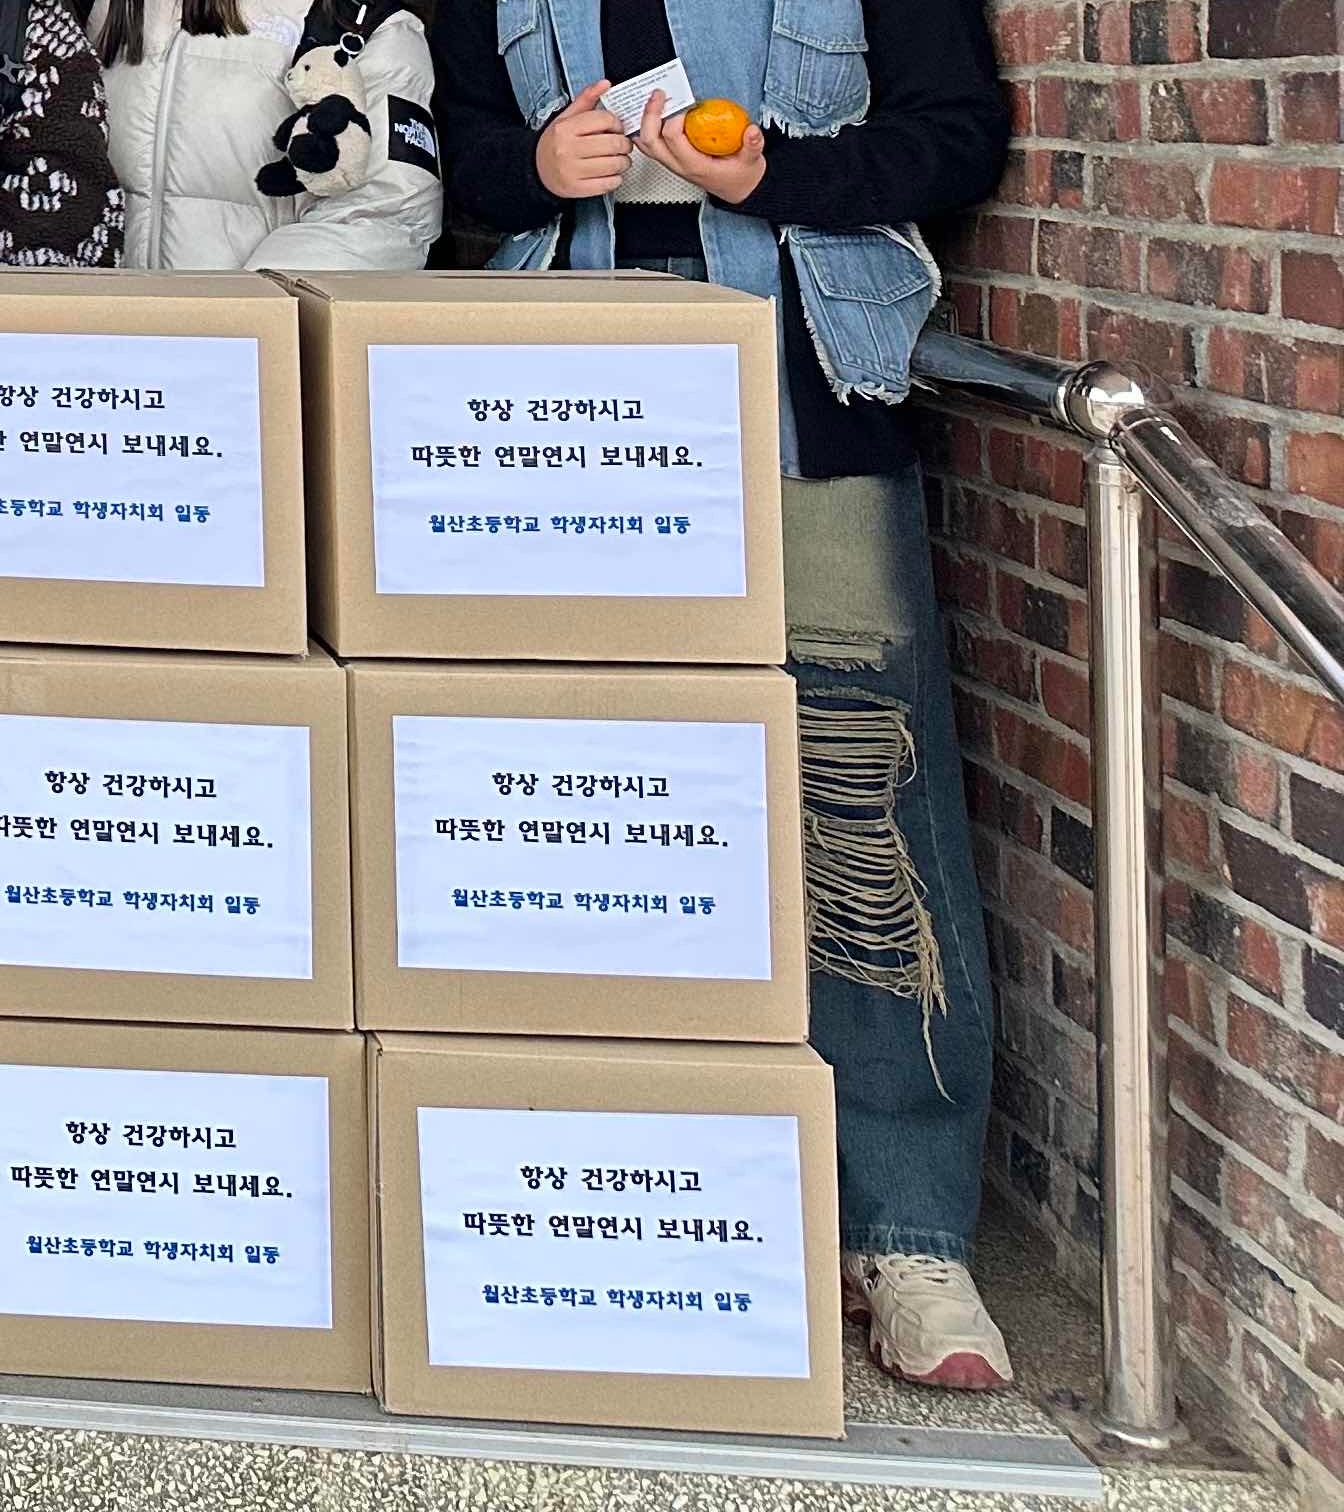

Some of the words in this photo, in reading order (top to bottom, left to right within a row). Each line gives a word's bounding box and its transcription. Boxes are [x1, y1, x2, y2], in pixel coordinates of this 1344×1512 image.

[50, 385, 165, 411] 건강하시고
[466, 397, 515, 422] 항상
[526, 398, 644, 422] 건강하시고
[18, 430, 108, 456] 연말연시
[120, 433, 223, 458] 보내세요.
[409, 444, 482, 468] 따뜻한
[493, 444, 586, 469] 연말연시
[599, 444, 703, 468] 보내세요.
[71, 499, 164, 522] 학생자치회
[174, 503, 211, 524] 일동
[427, 513, 541, 534] 월산초등학교
[548, 514, 643, 535] 학생자치회
[653, 514, 691, 535] 일동
[43, 769, 91, 795] 항상
[101, 773, 217, 800] 건강하시고
[490, 771, 540, 796] 항상
[550, 773, 670, 799] 건강하시고
[69, 817, 159, 845] 연말연시
[171, 822, 273, 849] 보내세요.
[433, 816, 506, 842] 따뜻한
[517, 819, 610, 845] 연말연시
[623, 822, 728, 848] 보내세요.
[3, 883, 114, 908] 월산초등학교
[121, 889, 214, 913] 학생자치회
[223, 894, 261, 915] 일동
[450, 887, 564, 910] 월산초등학교
[572, 891, 668, 914] 학생자치회
[678, 894, 716, 915] 일동
[64, 1120, 111, 1146] 항상
[121, 1123, 237, 1150] 건강하시고
[9, 1164, 79, 1190] 따뜻한
[89, 1168, 179, 1195] 연말연시
[191, 1172, 292, 1198] 보내세요.
[518, 1164, 568, 1191] 항상
[580, 1166, 702, 1194] 건강하시고
[461, 1211, 536, 1237] 따뜻한
[547, 1214, 643, 1241] 연말연시
[655, 1217, 763, 1243] 보내세요.
[25, 1234, 134, 1258] 월산초등학교
[142, 1239, 234, 1263] 학생자치회
[243, 1244, 281, 1265] 일동
[481, 1283, 598, 1307] 월산초등학교
[605, 1288, 703, 1311] 학생자치회
[713, 1291, 752, 1312] 일동
